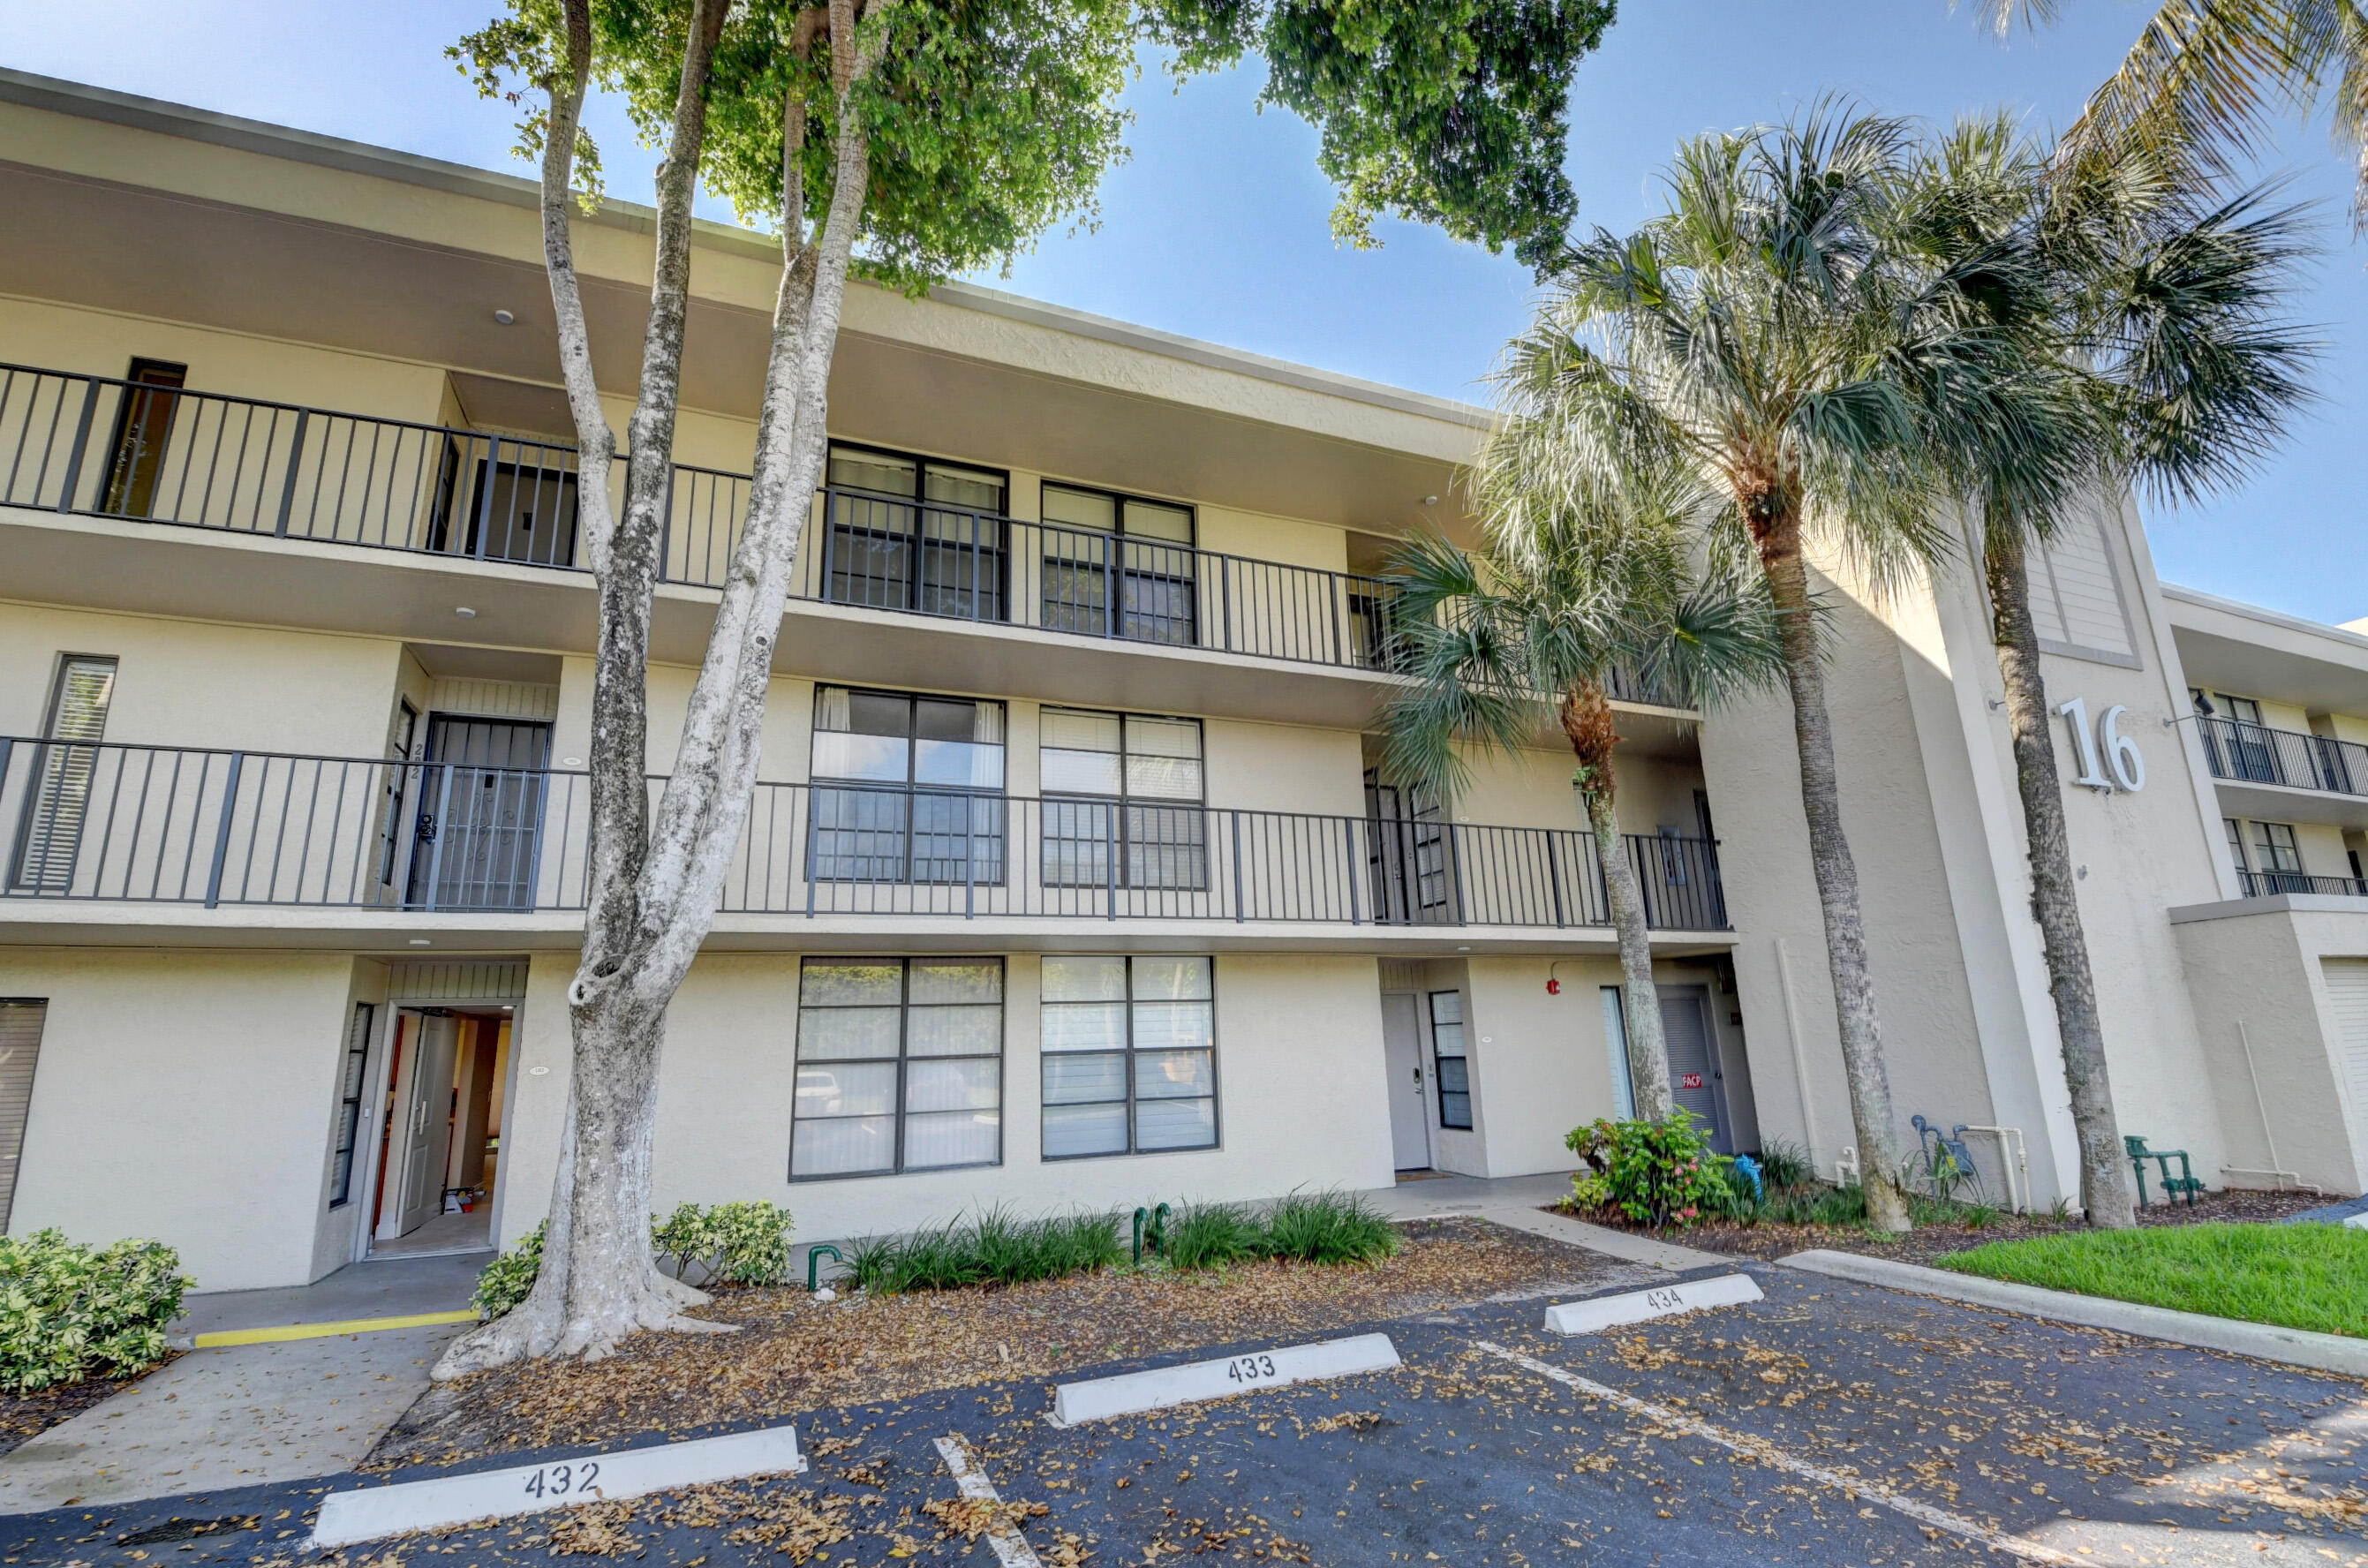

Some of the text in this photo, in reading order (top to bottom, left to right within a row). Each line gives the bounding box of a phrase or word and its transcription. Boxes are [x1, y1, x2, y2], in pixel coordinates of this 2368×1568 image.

[2059, 697, 2146, 792] 16
[1682, 1075, 1701, 1087] FACP
[1647, 1289, 1684, 1309] 434
[1229, 1355, 1276, 1383] 433
[525, 1462, 600, 1498] 432
